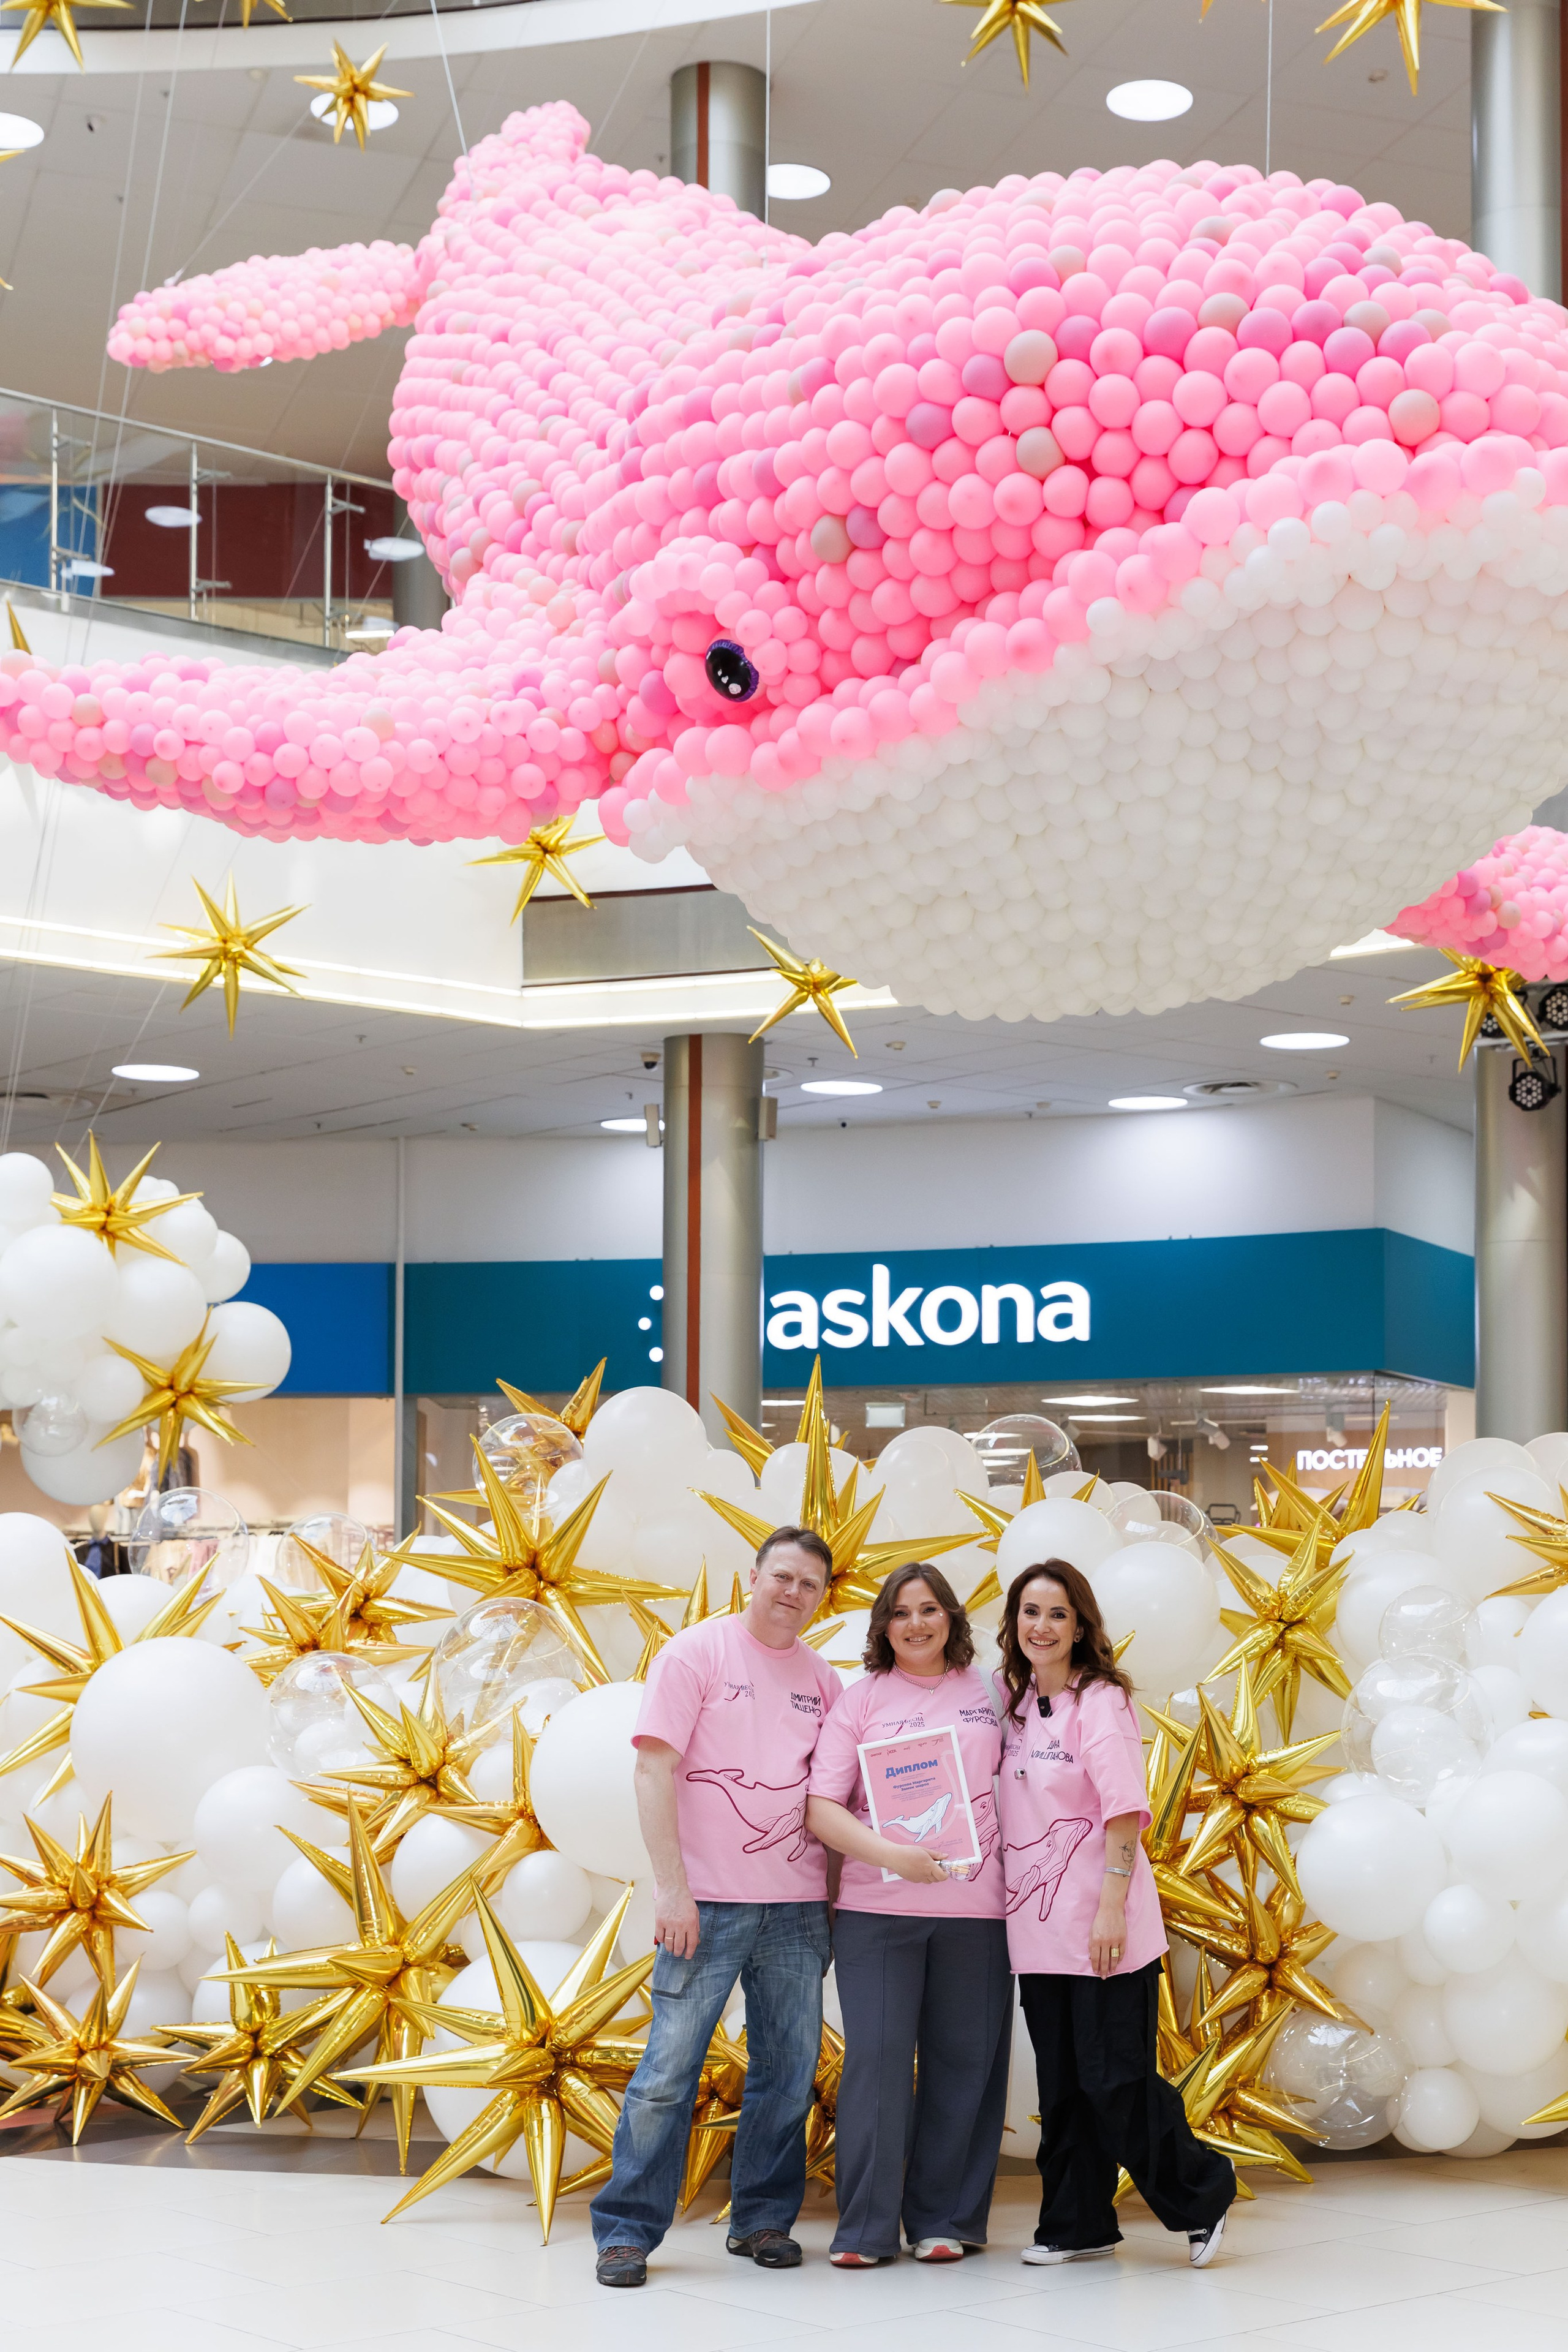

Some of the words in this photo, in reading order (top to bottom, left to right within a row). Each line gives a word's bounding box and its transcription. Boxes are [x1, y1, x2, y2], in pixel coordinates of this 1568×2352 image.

[766, 1264, 1090, 1349] askona
[1296, 1447, 1443, 1471] ПОСТЕЬНОЕ
[791, 1692, 821, 1706] ДМИТРИЙ
[959, 1707, 996, 1717] МАРГАРИТА
[963, 1716, 999, 1728] ФУРСОВА
[886, 1759, 938, 1779] Диплом
